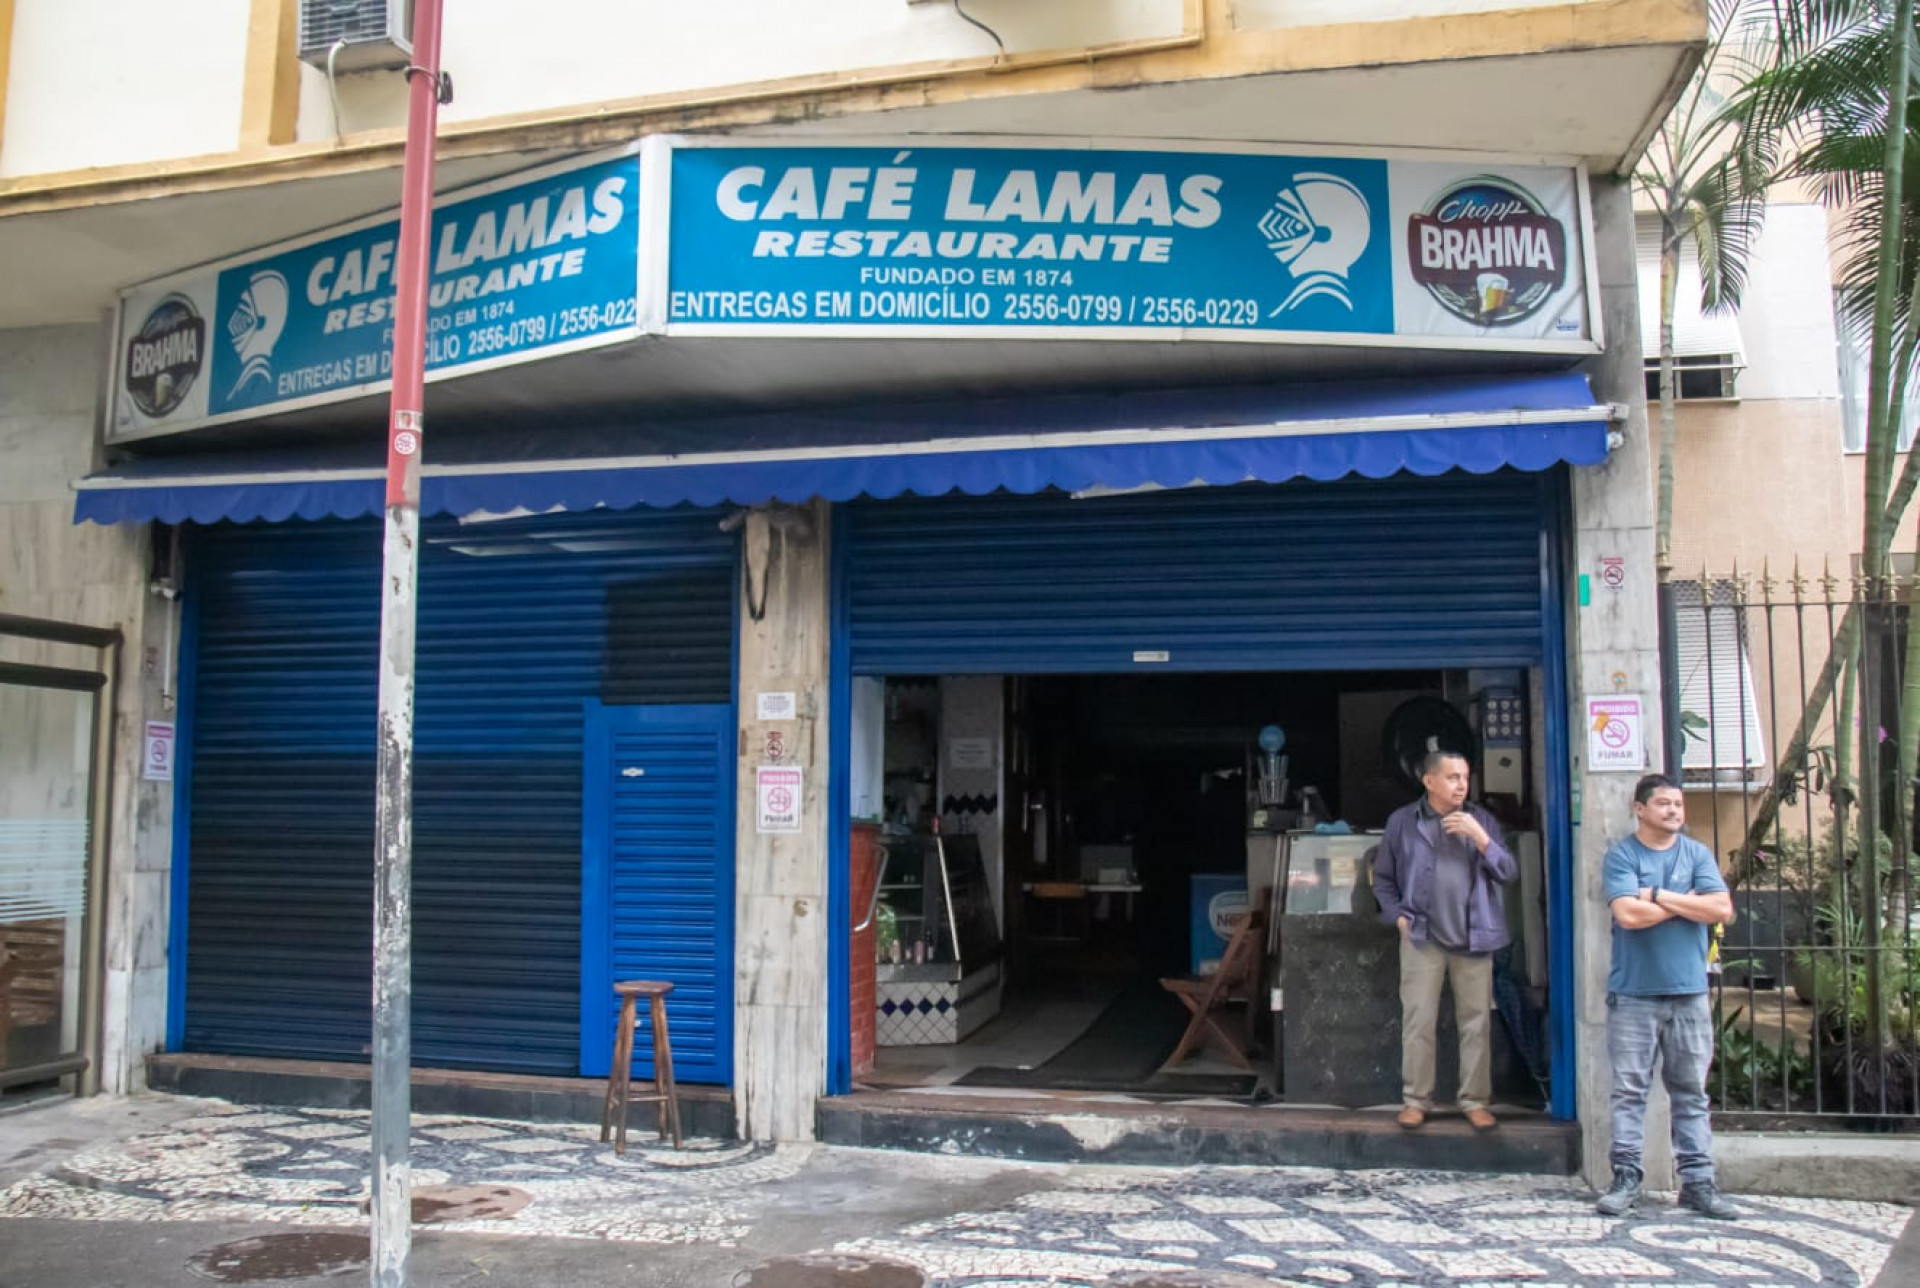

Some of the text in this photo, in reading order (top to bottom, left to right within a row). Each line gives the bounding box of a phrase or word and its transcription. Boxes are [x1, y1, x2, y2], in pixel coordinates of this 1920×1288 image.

[716, 151, 1224, 229] CAFÉ LAMAS
[1437, 199, 1530, 223] Chopp
[307, 176, 627, 306] CAF LAMAS
[753, 230, 1174, 264] RESTAURANTE
[1420, 223, 1555, 271] BRAHMA
[324, 248, 587, 335] RESTURANTE
[860, 266, 1073, 286] FUNDADO EM 1874
[455, 300, 515, 327] EM 1874
[671, 286, 1259, 325] ENTREGAS EM DOMICÍLIO 2556-0799 / 2556-0229
[131, 327, 198, 378] BRAHMA
[278, 359, 351, 395] ENTREGAS
[355, 353, 377, 378] EM
[381, 333, 460, 374] DÍLIO
[468, 315, 546, 355] 2556-0799
[549, 313, 557, 338] /
[559, 296, 637, 336] 2556-022
